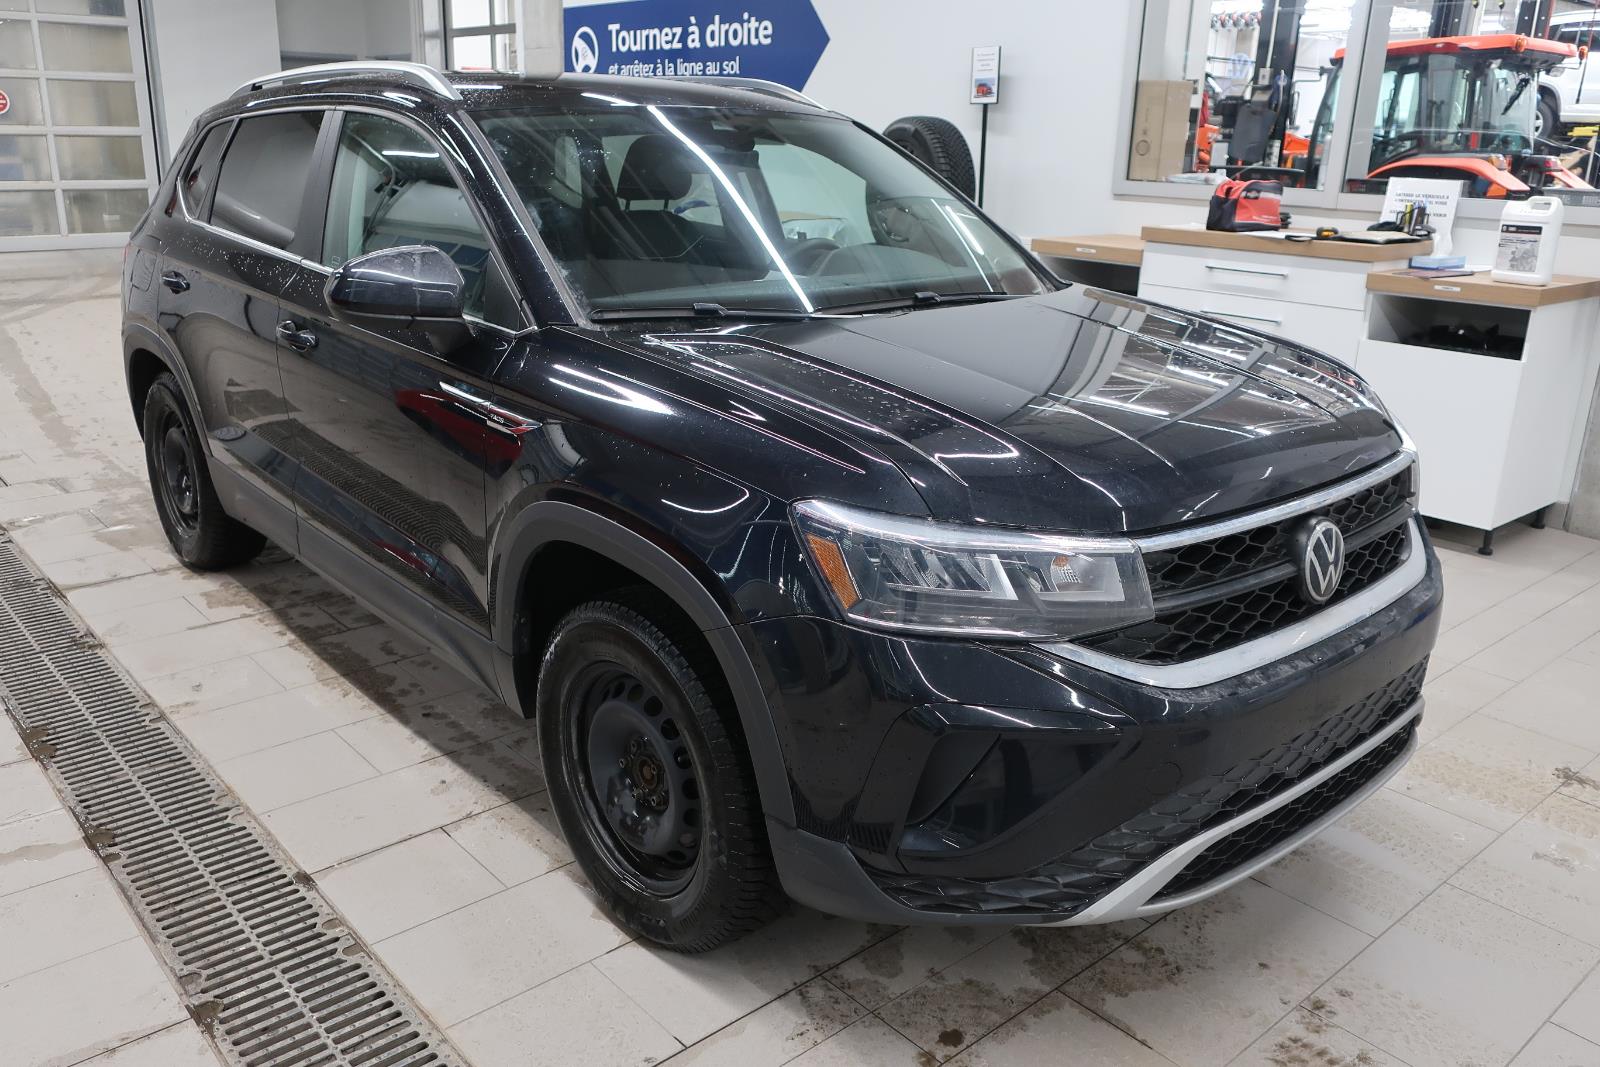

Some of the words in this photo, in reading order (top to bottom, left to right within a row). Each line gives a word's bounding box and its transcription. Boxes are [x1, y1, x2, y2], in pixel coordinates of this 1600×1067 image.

[608, 23, 683, 53] Tournez
[687, 16, 701, 49] à
[705, 12, 773, 48] droite
[608, 63, 618, 75] et
[620, 60, 654, 77] arrêtez
[656, 59, 663, 76] à
[665, 58, 674, 75] la
[677, 58, 703, 77] ligne
[706, 60, 720, 75] au
[722, 55, 740, 74] sol
[1306, 523, 1344, 599] VW
